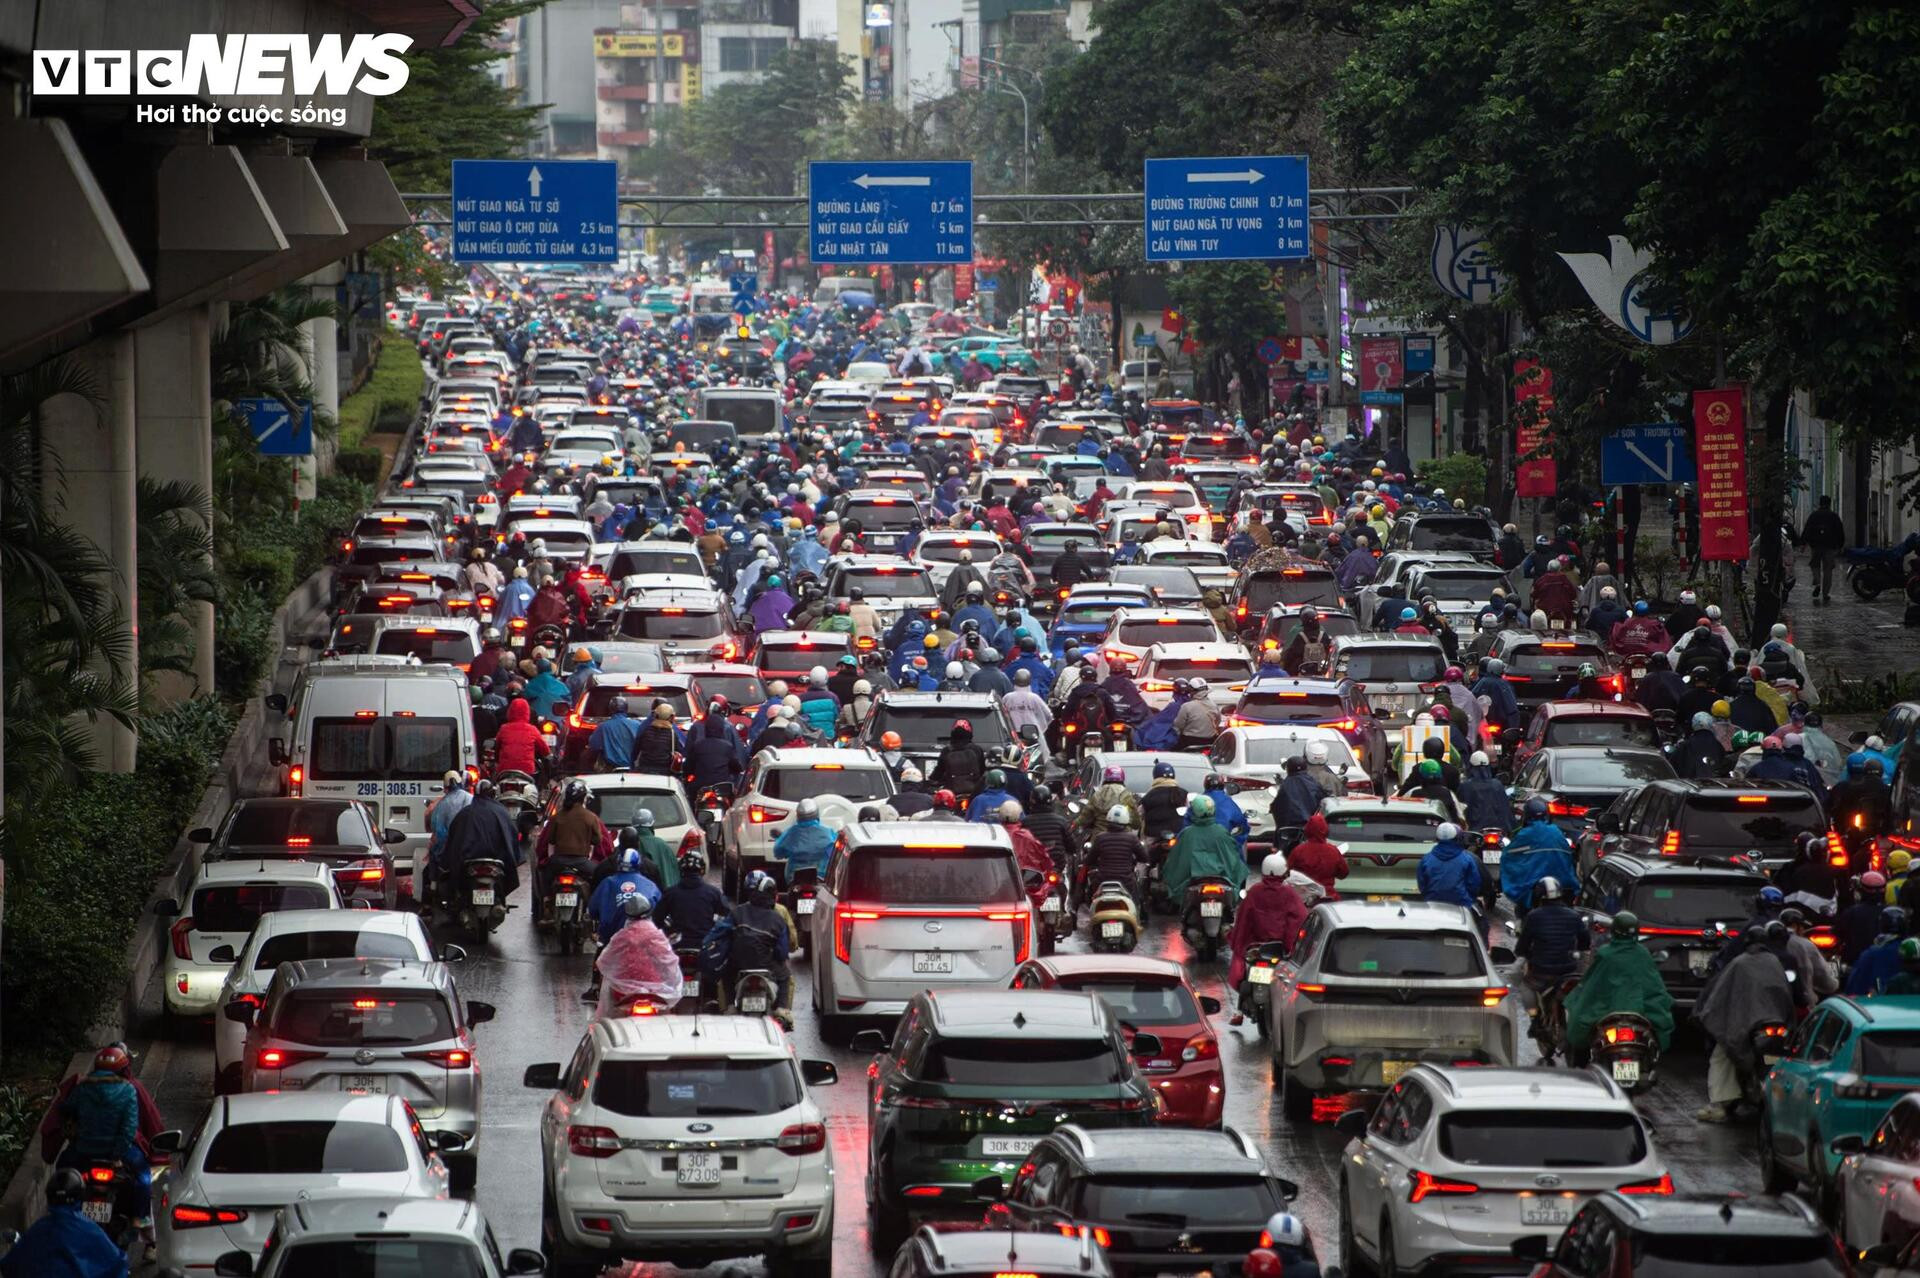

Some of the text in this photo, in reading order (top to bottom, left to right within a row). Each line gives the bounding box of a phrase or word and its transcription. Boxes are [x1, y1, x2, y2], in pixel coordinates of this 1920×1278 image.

[457, 196, 476, 212] NÚT
[479, 200, 501, 212] GIAO
[505, 198, 525, 213] NGÃ
[529, 200, 542, 213] TƯ
[948, 201, 964, 213] km
[1188, 194, 1226, 210] TRƯỜNG
[1230, 197, 1259, 209] CHINH
[1287, 196, 1302, 208] km
[457, 218, 476, 234] NÚT
[479, 221, 501, 234] GIAO
[515, 221, 535, 237] CHỢ
[539, 218, 559, 234] DỪA
[598, 222, 613, 234] km
[818, 217, 964, 234] NÚT GIAO CẦU GIẤY 5 km
[1151, 216, 1170, 231] NÚT
[1173, 219, 1195, 231] GIAO
[1197, 216, 1217, 231] NGÃ
[1236, 218, 1262, 232] VỌNG
[1278, 218, 1285, 229] 3
[1287, 217, 1302, 229] km
[479, 238, 503, 254] MIẾU
[506, 238, 532, 254] QUỐC
[550, 240, 575, 254] GIÁM
[598, 242, 613, 255] km
[818, 240, 964, 256] CẦU NHẬT TÂN 11 km
[1151, 237, 1302, 252] CẦU VĨNH TUY 8 km
[387, 783, 422, 795] 308.51
[688, 1152, 710, 1168] 30F
[679, 1168, 719, 1182] 673.08
